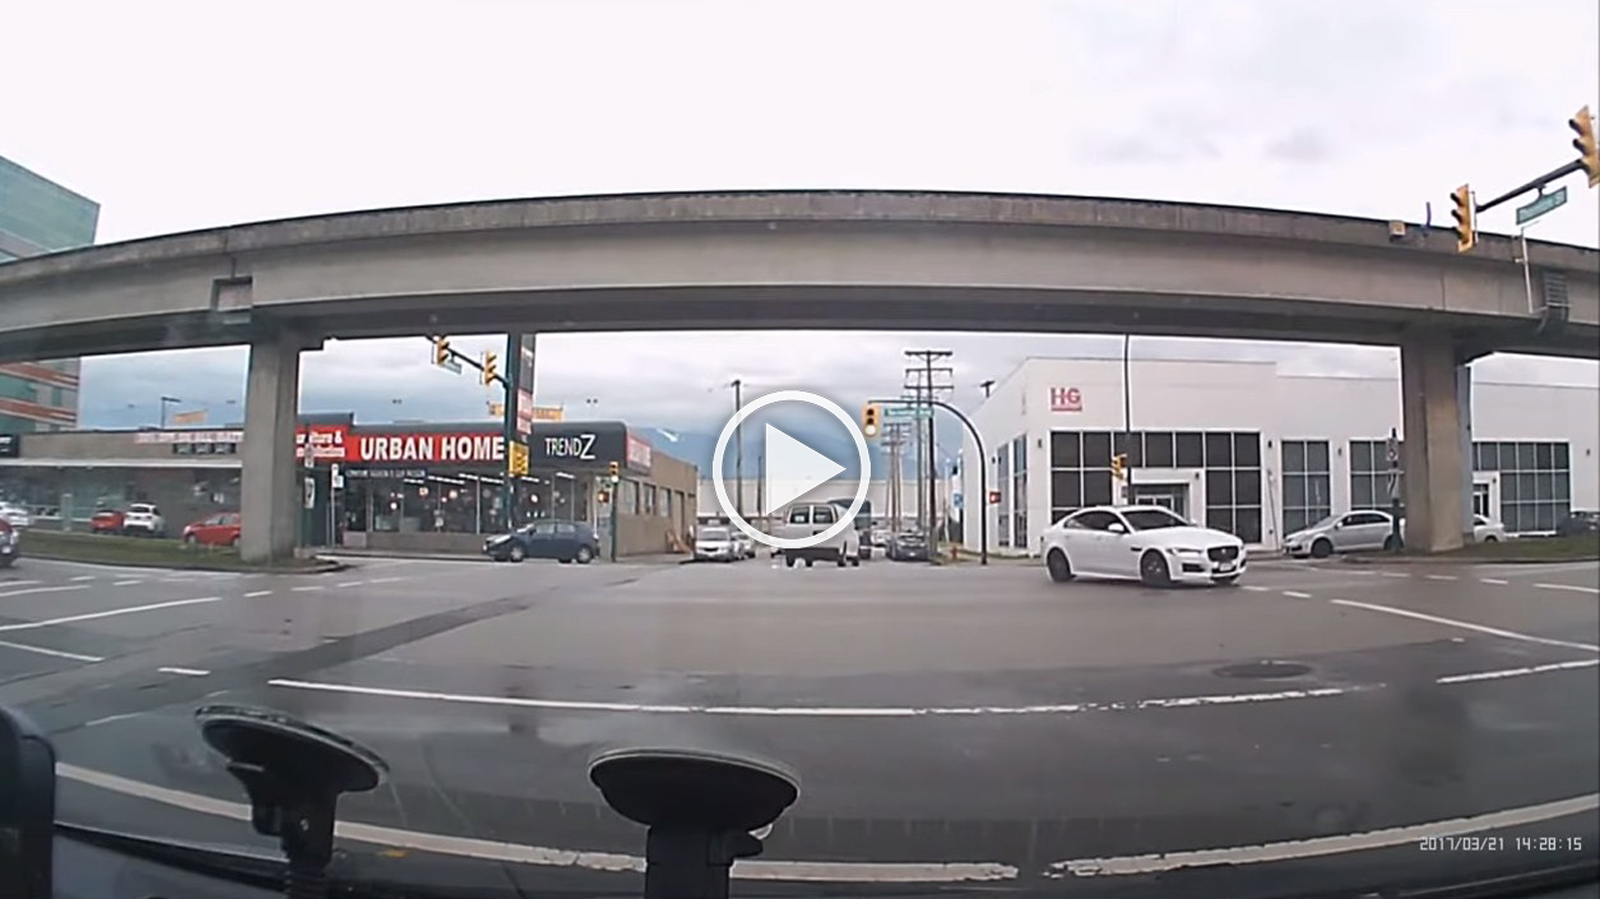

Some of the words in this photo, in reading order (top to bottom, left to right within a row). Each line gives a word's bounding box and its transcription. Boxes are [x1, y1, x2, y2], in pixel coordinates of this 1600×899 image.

[1050, 387, 1081, 405] HG
[360, 436, 433, 460] URBAN
[441, 436, 504, 460] HOME
